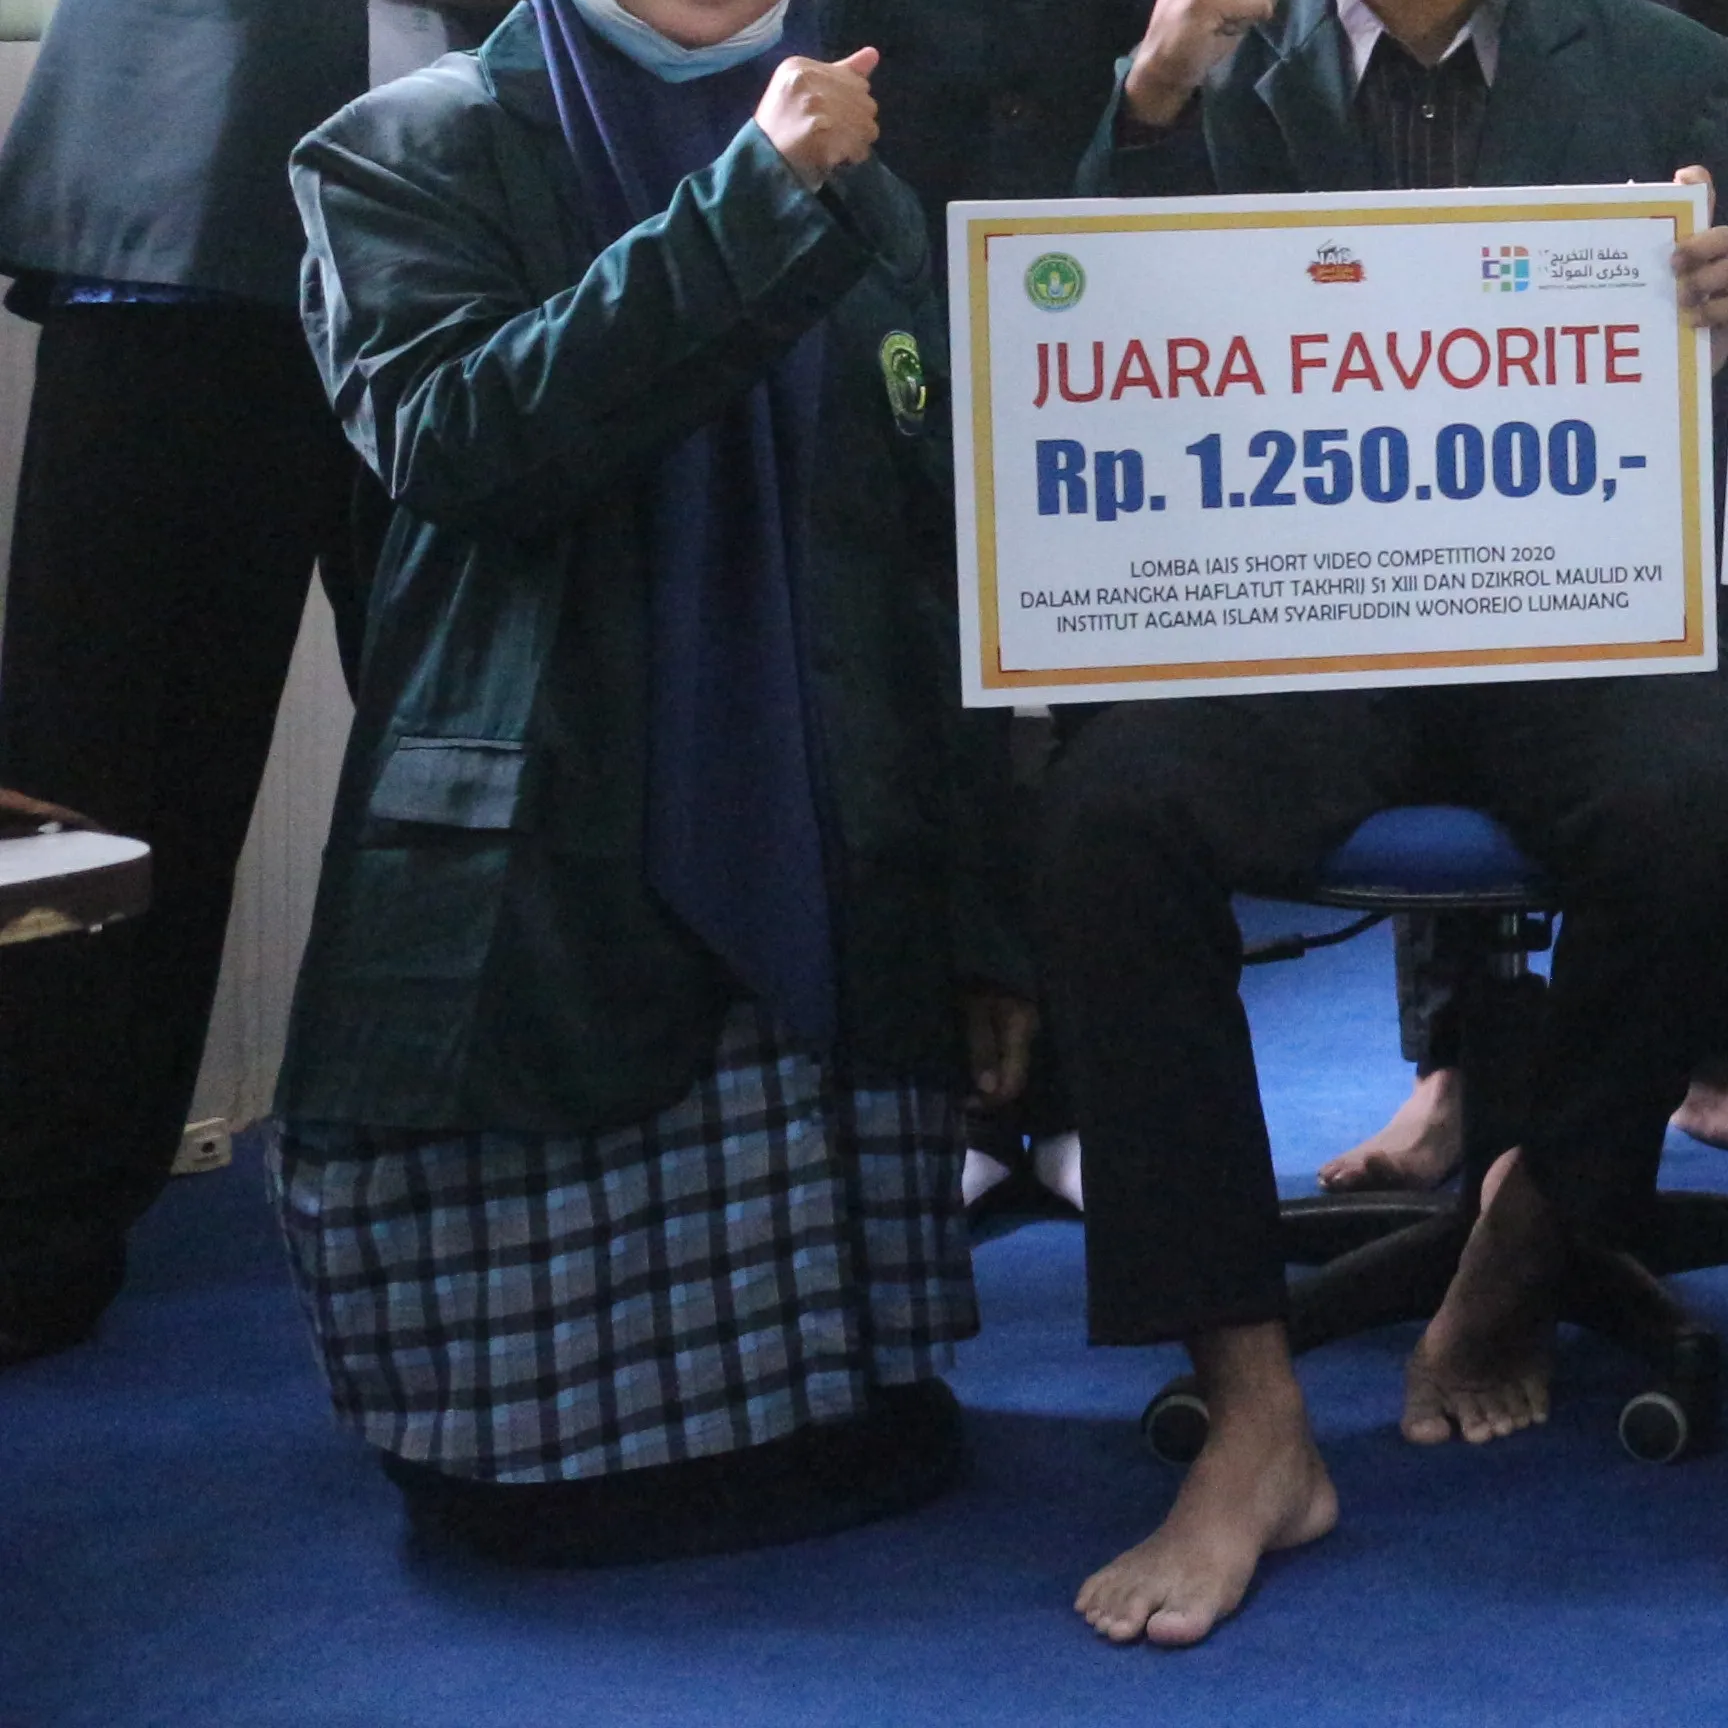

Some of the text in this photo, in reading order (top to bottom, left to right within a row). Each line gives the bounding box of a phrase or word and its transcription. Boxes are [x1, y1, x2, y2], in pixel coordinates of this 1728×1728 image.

[1031, 323, 1642, 409] JUARA FAVORITE
[1034, 418, 1646, 522] Rp. 1.250.000,-
[1129, 544, 1556, 579] LOMBA IAIS SHORT VIDEO COMPETITION 2020
[1019, 587, 1091, 610] DALAM
[1095, 584, 1179, 606] RANGKA
[1183, 579, 1285, 601] HAFLATUT
[1288, 576, 1365, 597] TAKHRIJ
[1390, 574, 1418, 593] XIII
[1422, 572, 1466, 591] DAN
[1470, 568, 1551, 589] DZIKROL
[1555, 565, 1628, 585] MAULID
[1632, 564, 1662, 582] XVI
[1055, 590, 1629, 633] INSTITUT AGAMA ISLAM SYARIFUDDIN WONOREJO LUMAJANG
